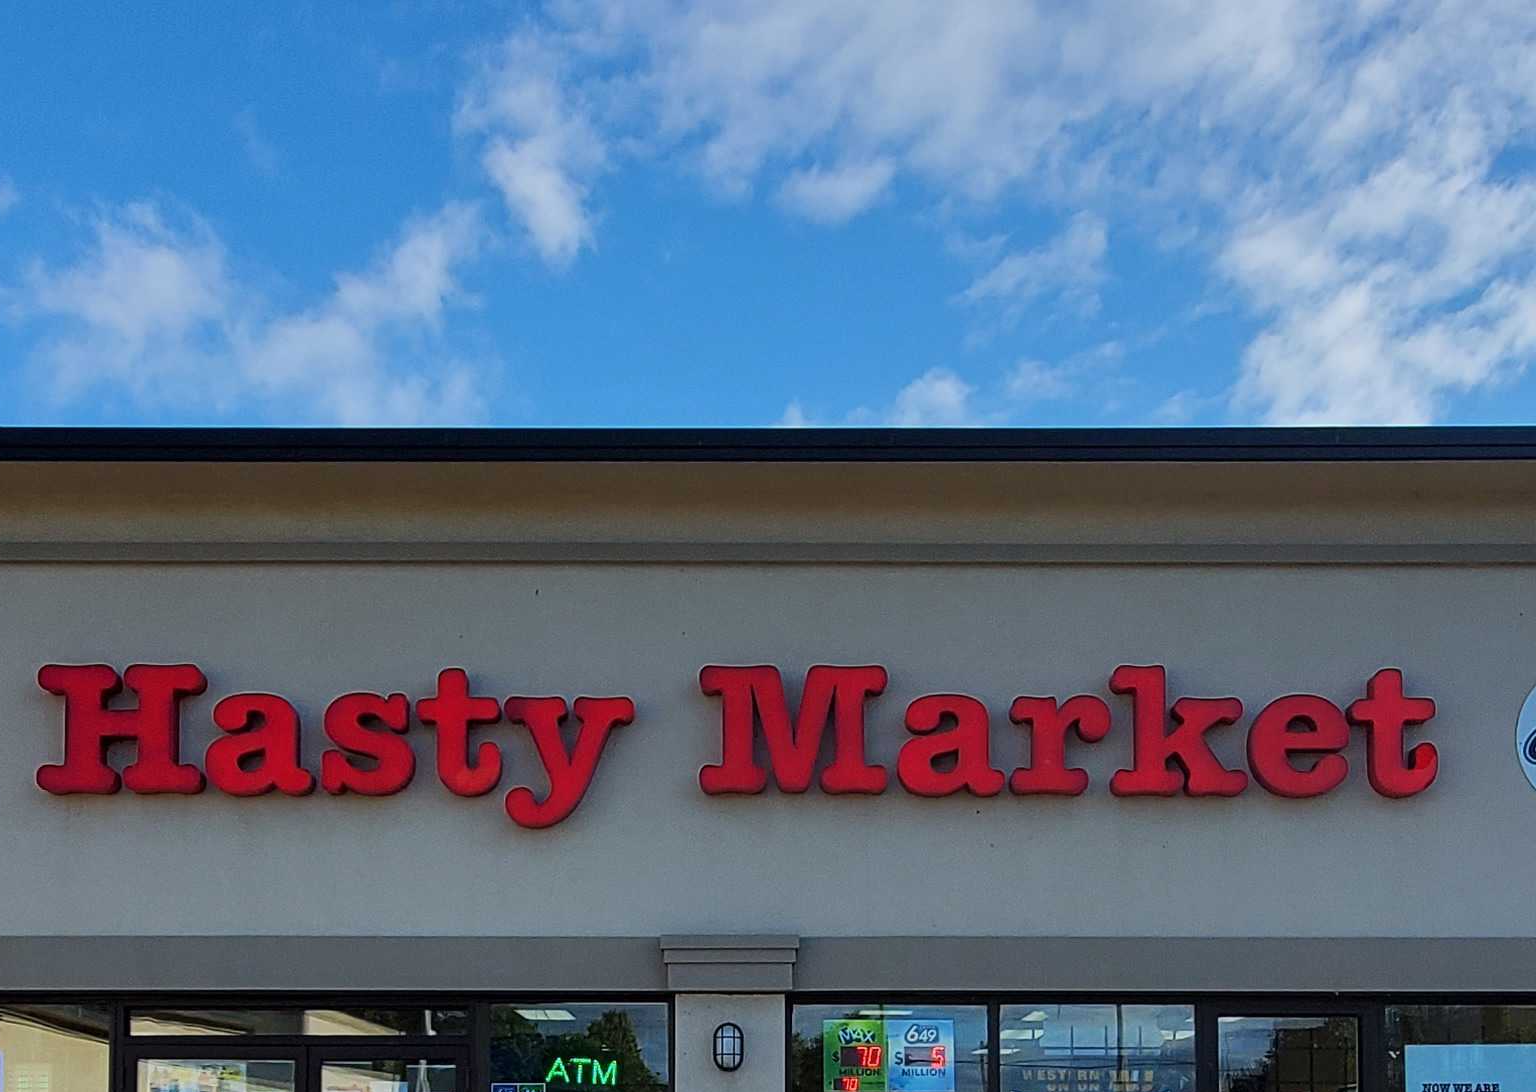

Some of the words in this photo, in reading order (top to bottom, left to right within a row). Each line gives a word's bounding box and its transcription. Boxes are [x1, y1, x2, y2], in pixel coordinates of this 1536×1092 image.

[37, 661, 635, 832] Hasty
[699, 662, 1440, 800] Market
[838, 1027, 875, 1044] MAX
[906, 1024, 938, 1043] 649
[856, 1046, 882, 1068] 70
[931, 1046, 946, 1068] 5
[545, 1057, 618, 1086] ATM
[839, 1068, 880, 1077] MILLION
[901, 1068, 946, 1077] MILLION
[1022, 1070, 1099, 1081] WESTRN
[841, 1077, 859, 1091] 70
